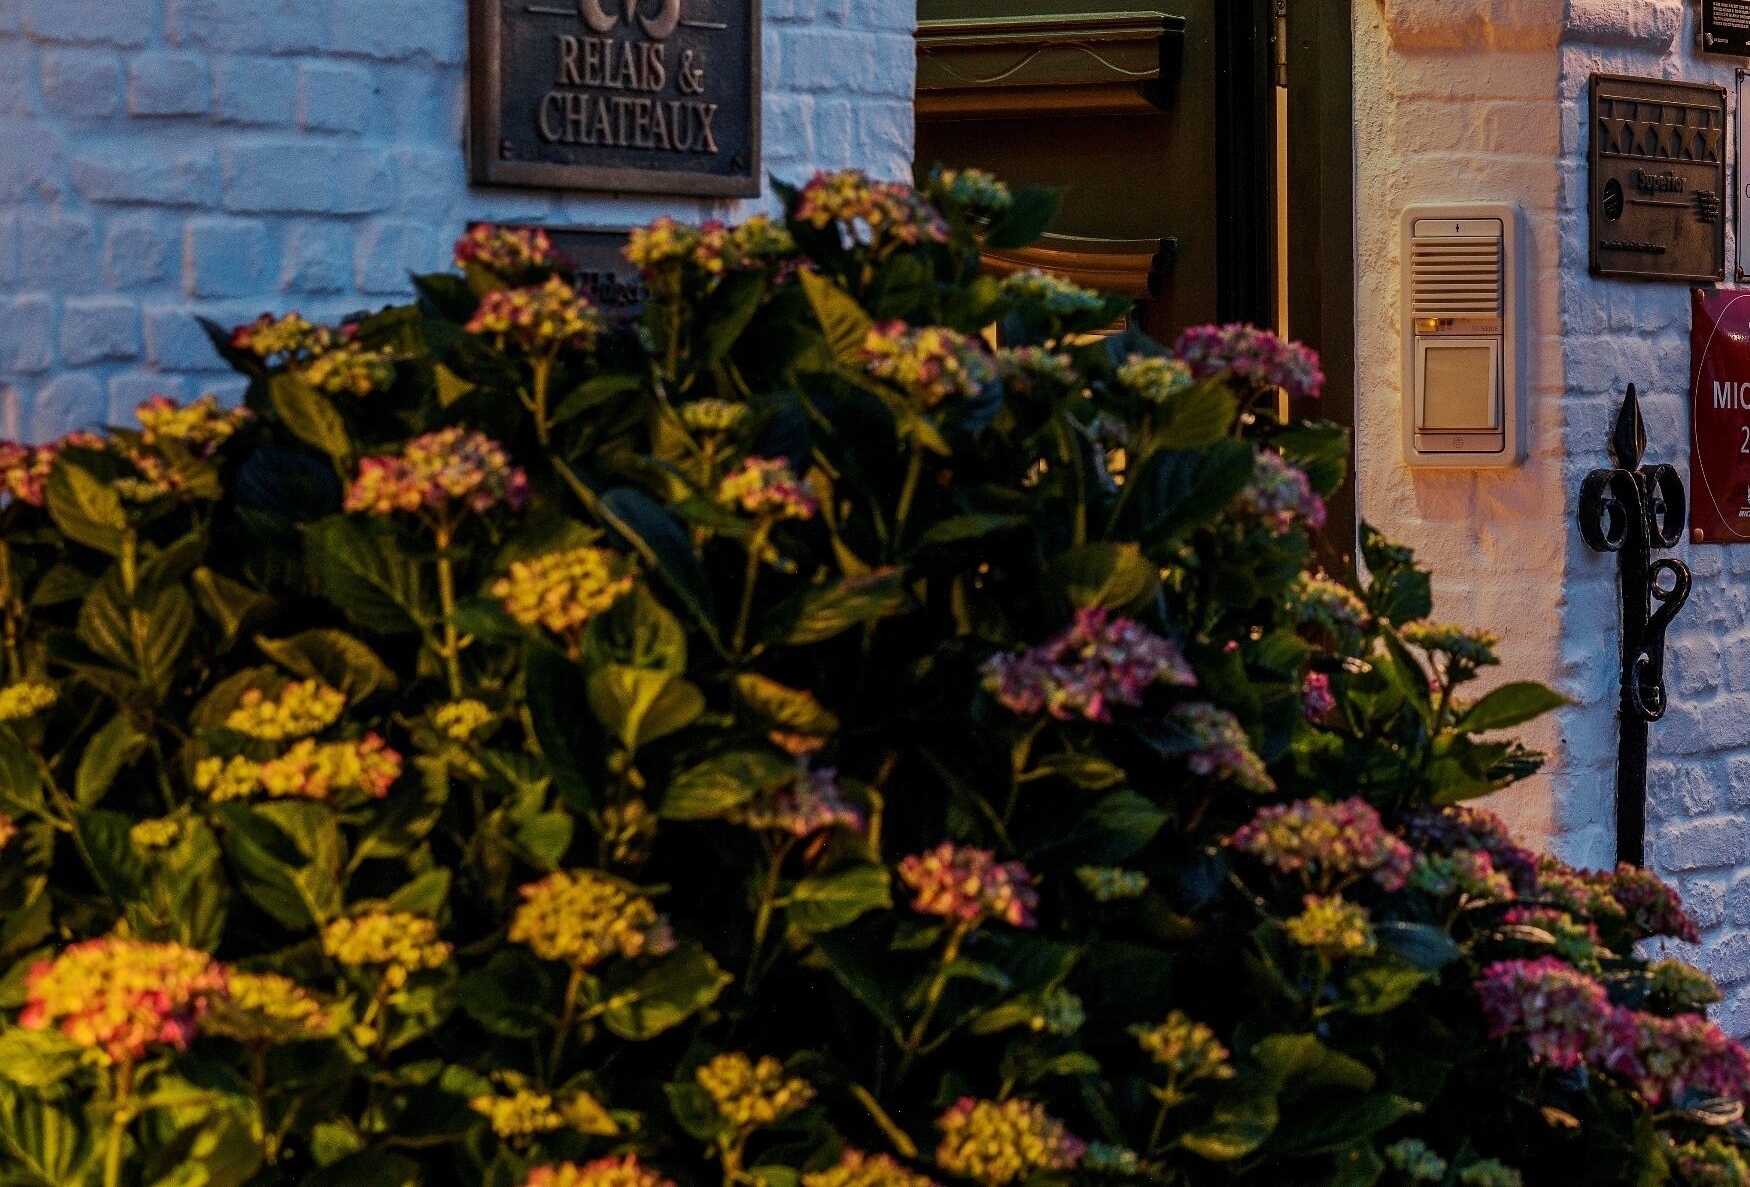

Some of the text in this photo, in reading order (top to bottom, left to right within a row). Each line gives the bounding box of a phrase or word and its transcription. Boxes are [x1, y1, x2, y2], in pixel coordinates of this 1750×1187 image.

[558, 34, 705, 94] RELAIS &
[539, 91, 720, 154] CHATEAUX
[1635, 167, 1687, 195] Superior
